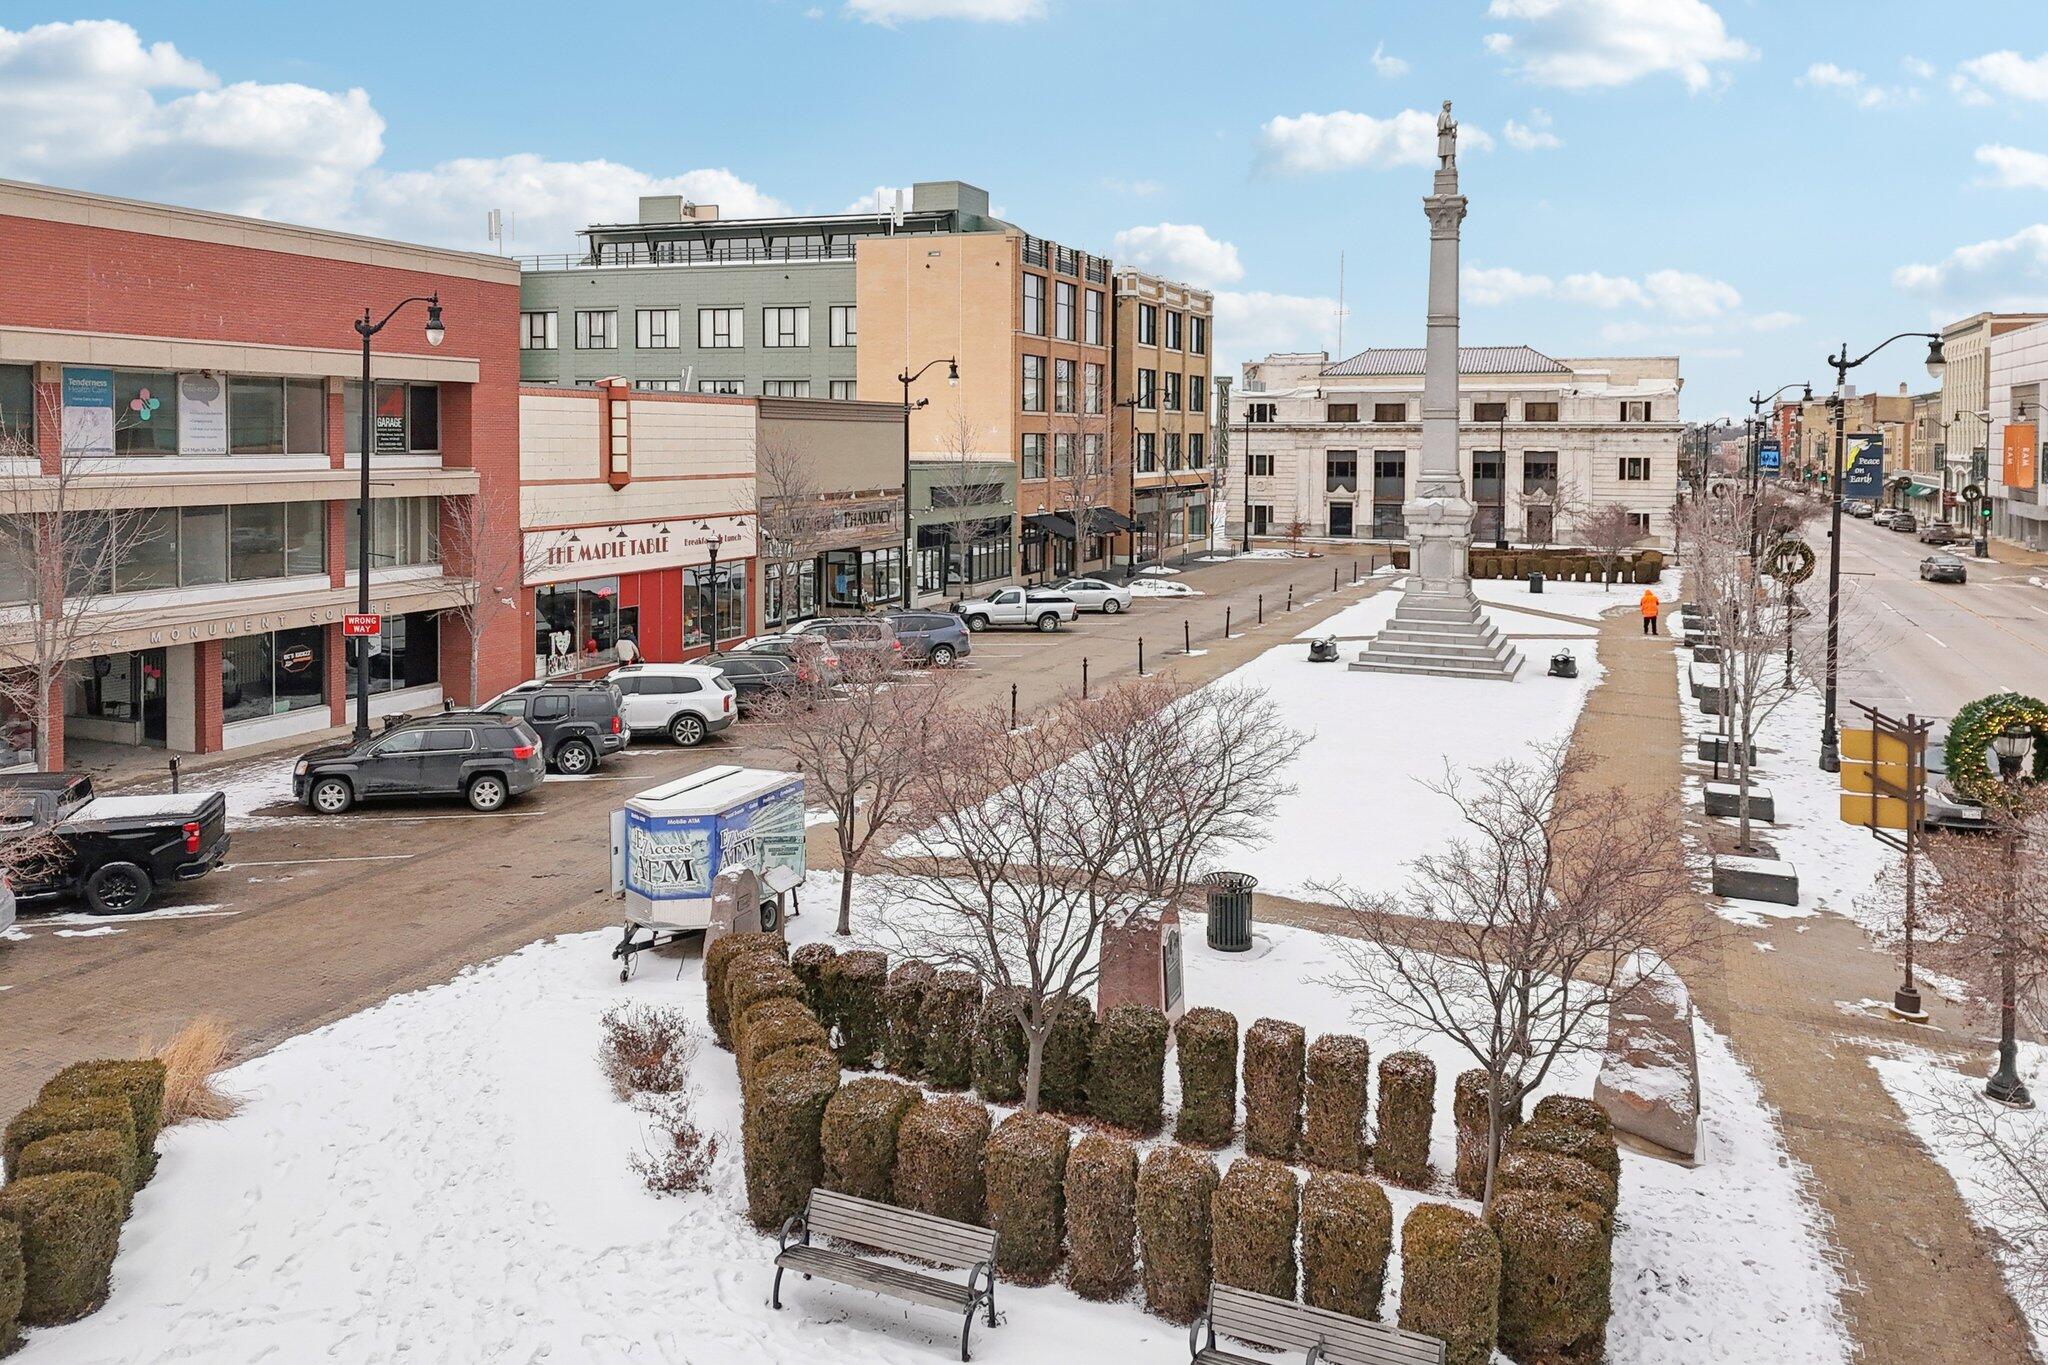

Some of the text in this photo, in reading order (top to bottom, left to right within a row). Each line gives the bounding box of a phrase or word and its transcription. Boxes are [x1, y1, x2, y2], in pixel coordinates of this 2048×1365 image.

[68, 378, 107, 387] Tenderness
[377, 416, 403, 428] GARAGE
[1221, 385, 1229, 465] VERDANT
[1859, 457, 1880, 465] Peace
[2022, 447, 2031, 467] RAM
[1850, 473, 1872, 484] Earth
[844, 510, 892, 528] PHARMACY
[547, 537, 669, 565] THE MAPLE TABLE
[151, 614, 286, 643] MONUMENT
[310, 602, 391, 622] SQURE
[647, 842, 692, 855] Access
[634, 855, 696, 883] ATM
